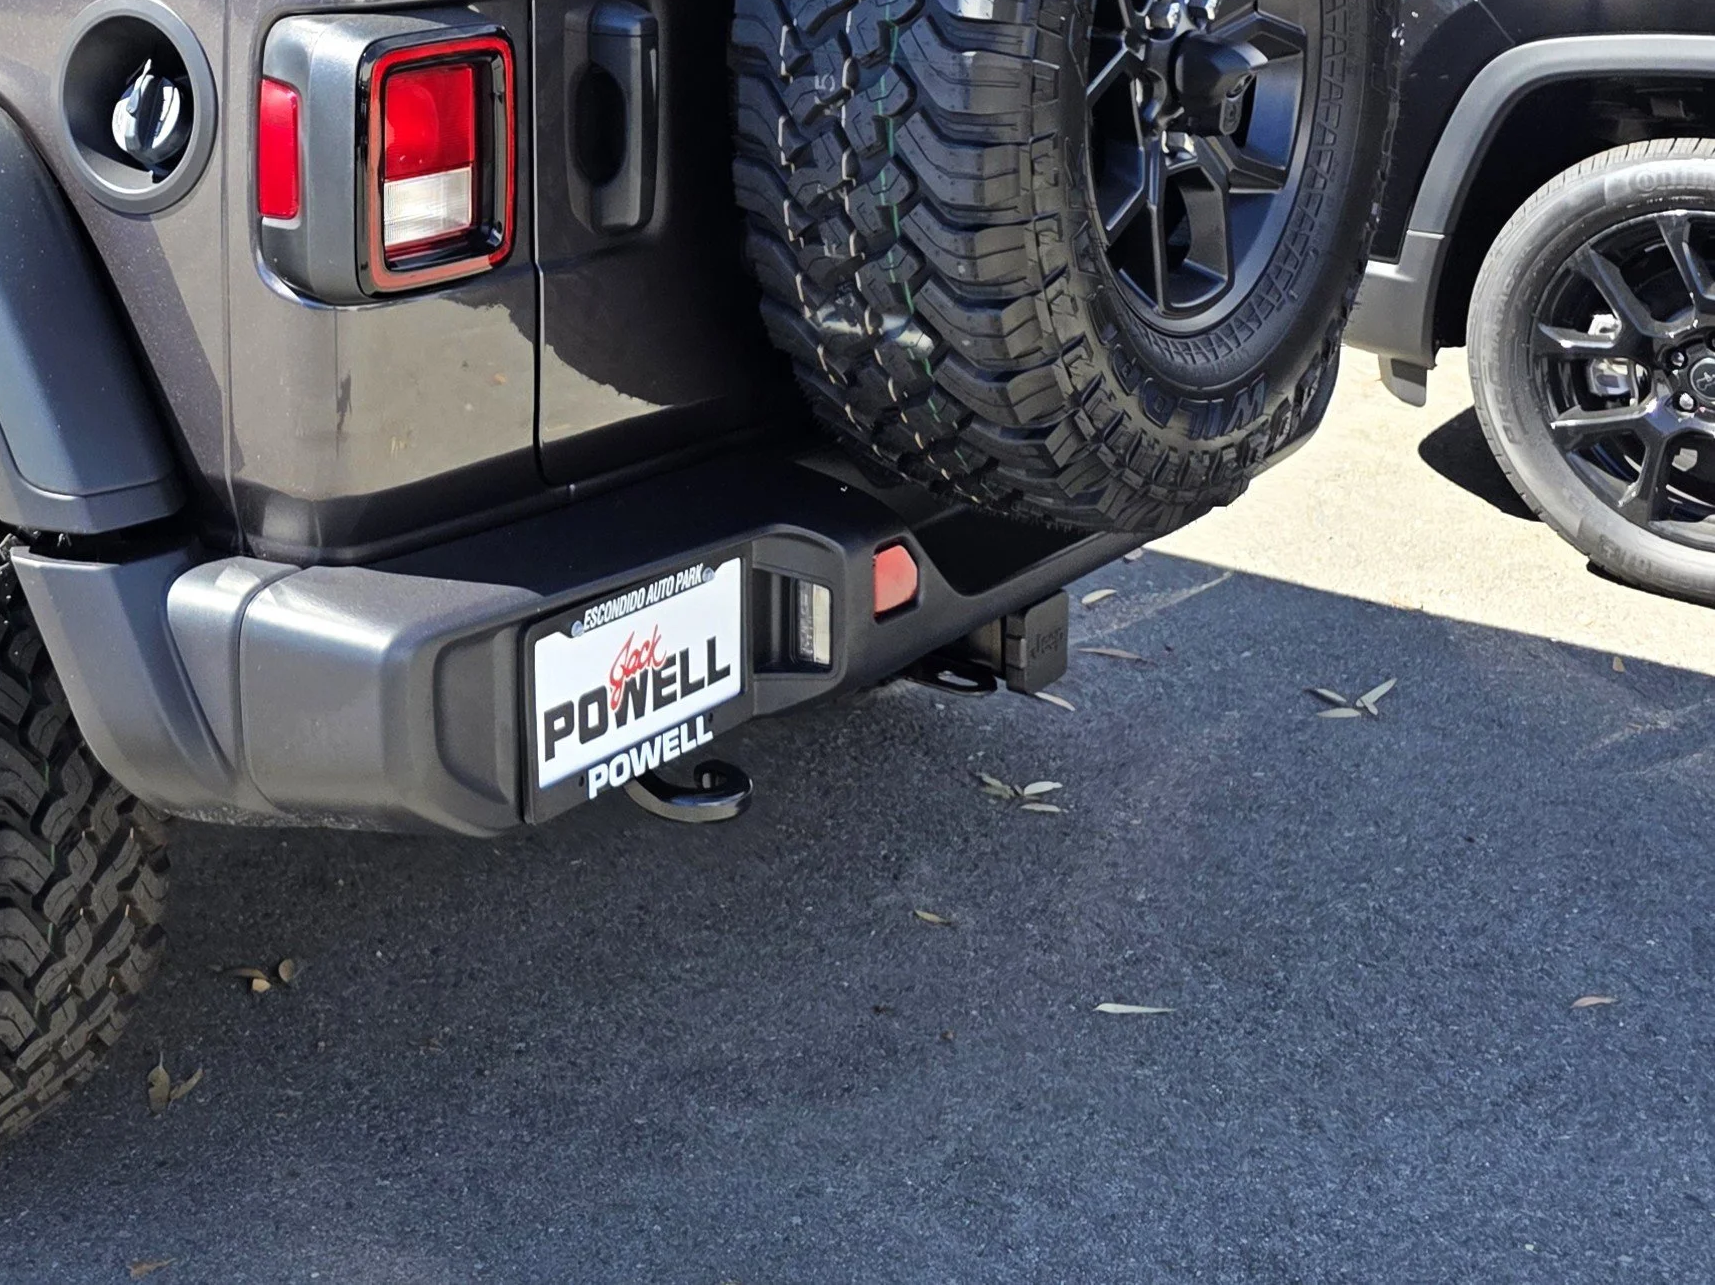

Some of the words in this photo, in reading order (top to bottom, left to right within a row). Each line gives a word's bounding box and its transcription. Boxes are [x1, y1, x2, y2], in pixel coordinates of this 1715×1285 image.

[583, 586, 645, 631] ESCONDIDO
[645, 577, 675, 605] AUTO
[674, 562, 704, 594] PARK
[543, 635, 731, 763] POWELL
[609, 623, 667, 711] Jack
[588, 714, 714, 800] POWELL
